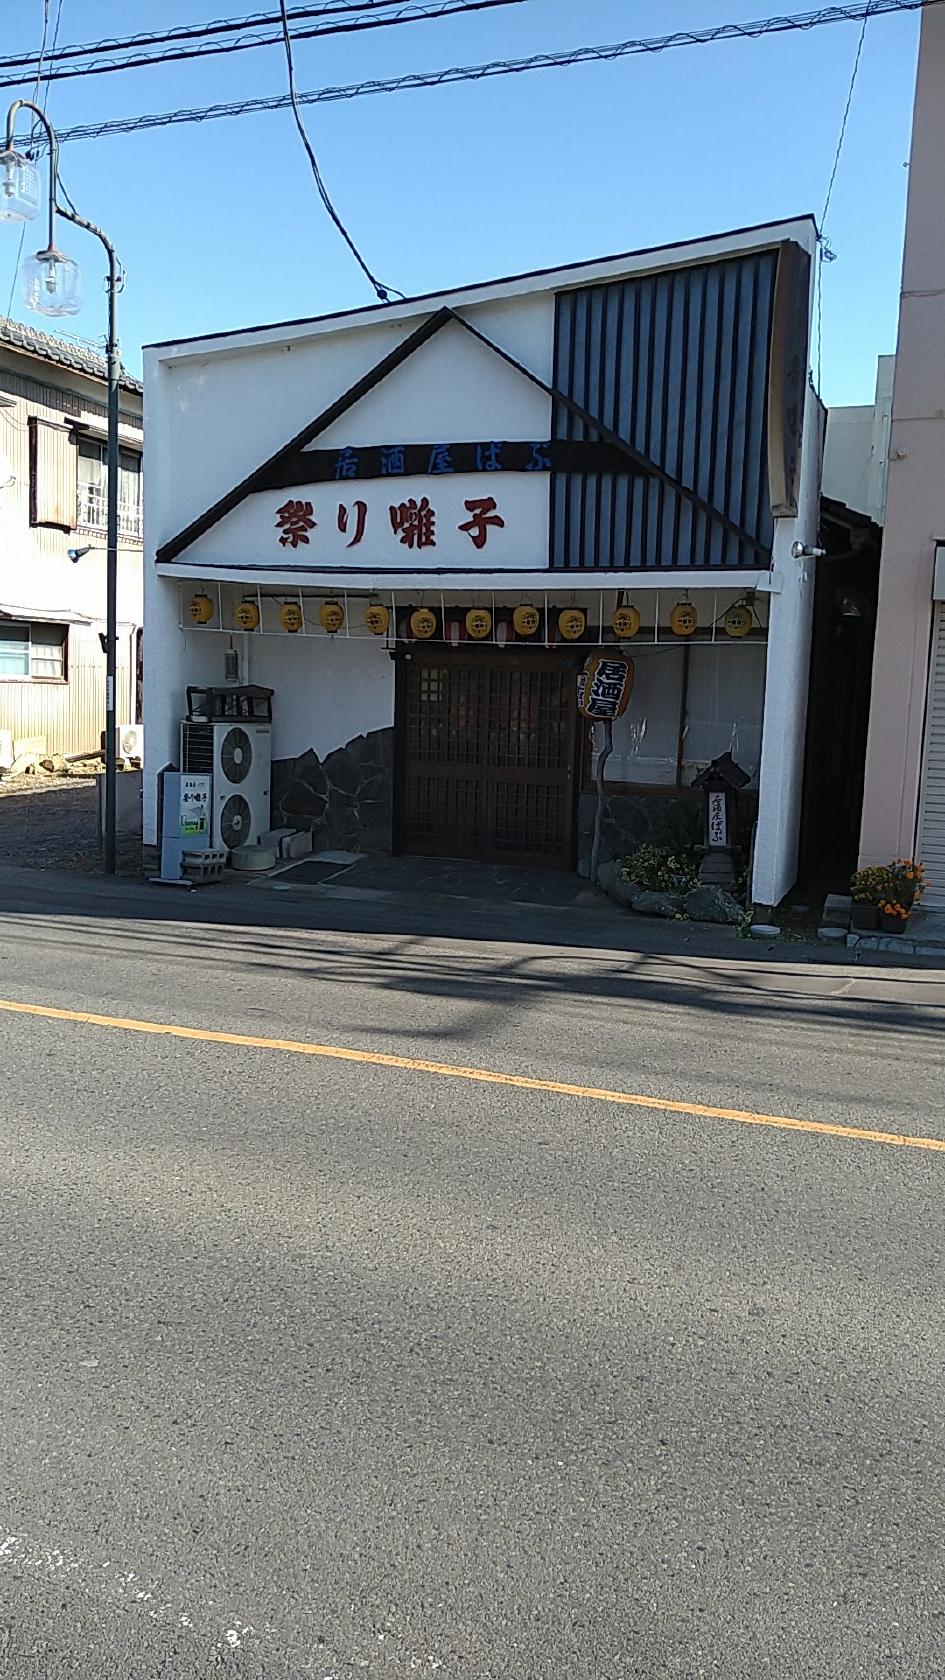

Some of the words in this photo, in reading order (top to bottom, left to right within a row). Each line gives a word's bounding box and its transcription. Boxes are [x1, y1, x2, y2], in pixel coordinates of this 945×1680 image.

[334, 440, 552, 480] 居酒屋ばぶ
[274, 496, 505, 549] 祭り囃子
[586, 660, 627, 717] 居酒屋
